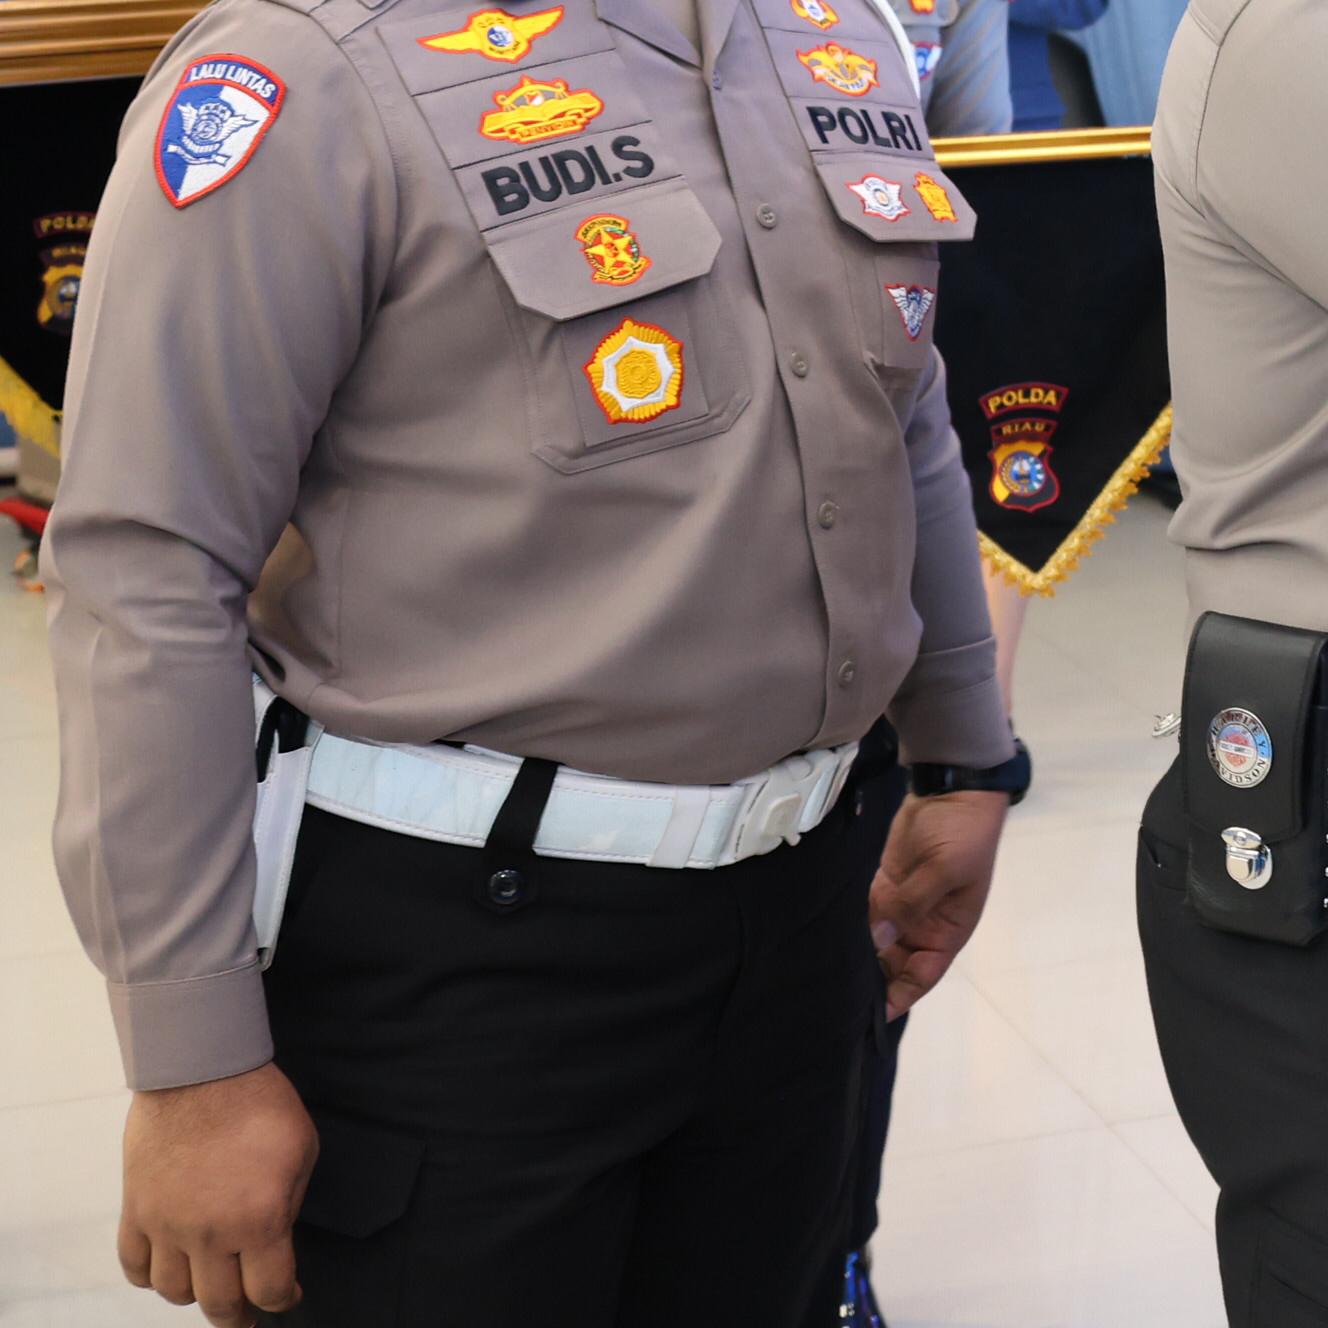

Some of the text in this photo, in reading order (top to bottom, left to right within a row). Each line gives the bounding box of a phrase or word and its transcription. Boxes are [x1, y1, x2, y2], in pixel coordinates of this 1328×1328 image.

[189, 63, 276, 99] LALU LINTAS
[805, 105, 923, 151] POLRI
[481, 135, 655, 217] BUDI.S
[987, 387, 1057, 414] POLDA
[1001, 421, 1045, 436] RIAU
